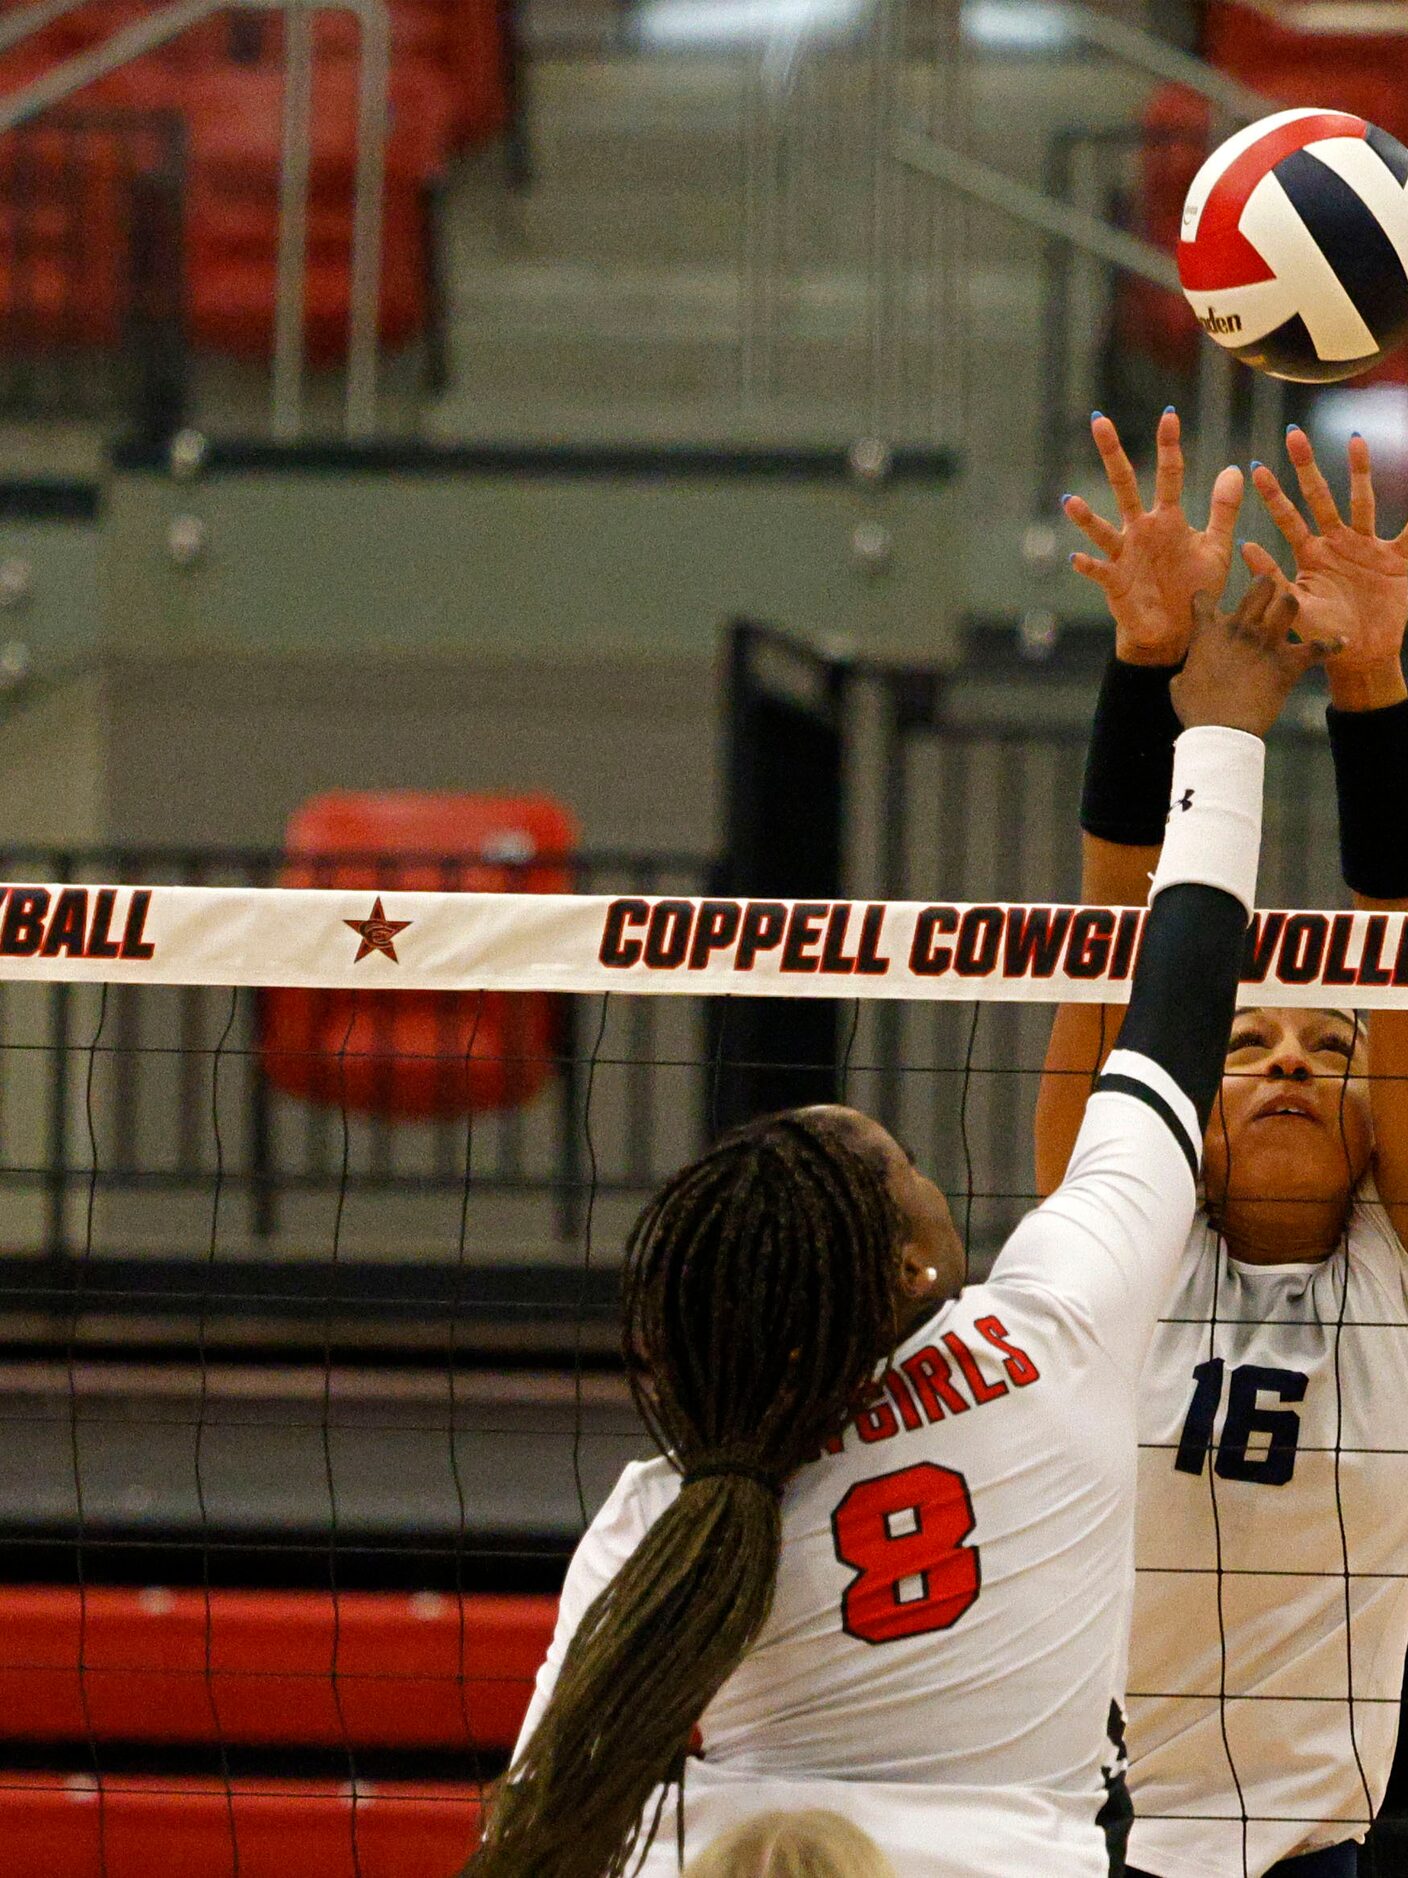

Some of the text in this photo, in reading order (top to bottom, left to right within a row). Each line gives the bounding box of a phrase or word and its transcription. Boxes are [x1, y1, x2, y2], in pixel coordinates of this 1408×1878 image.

[0, 887, 155, 960] BALL
[599, 899, 889, 975] COPPELL
[908, 906, 1150, 980] COWGI
[1175, 1357, 1309, 1487] 16
[831, 1461, 982, 1645] 8
